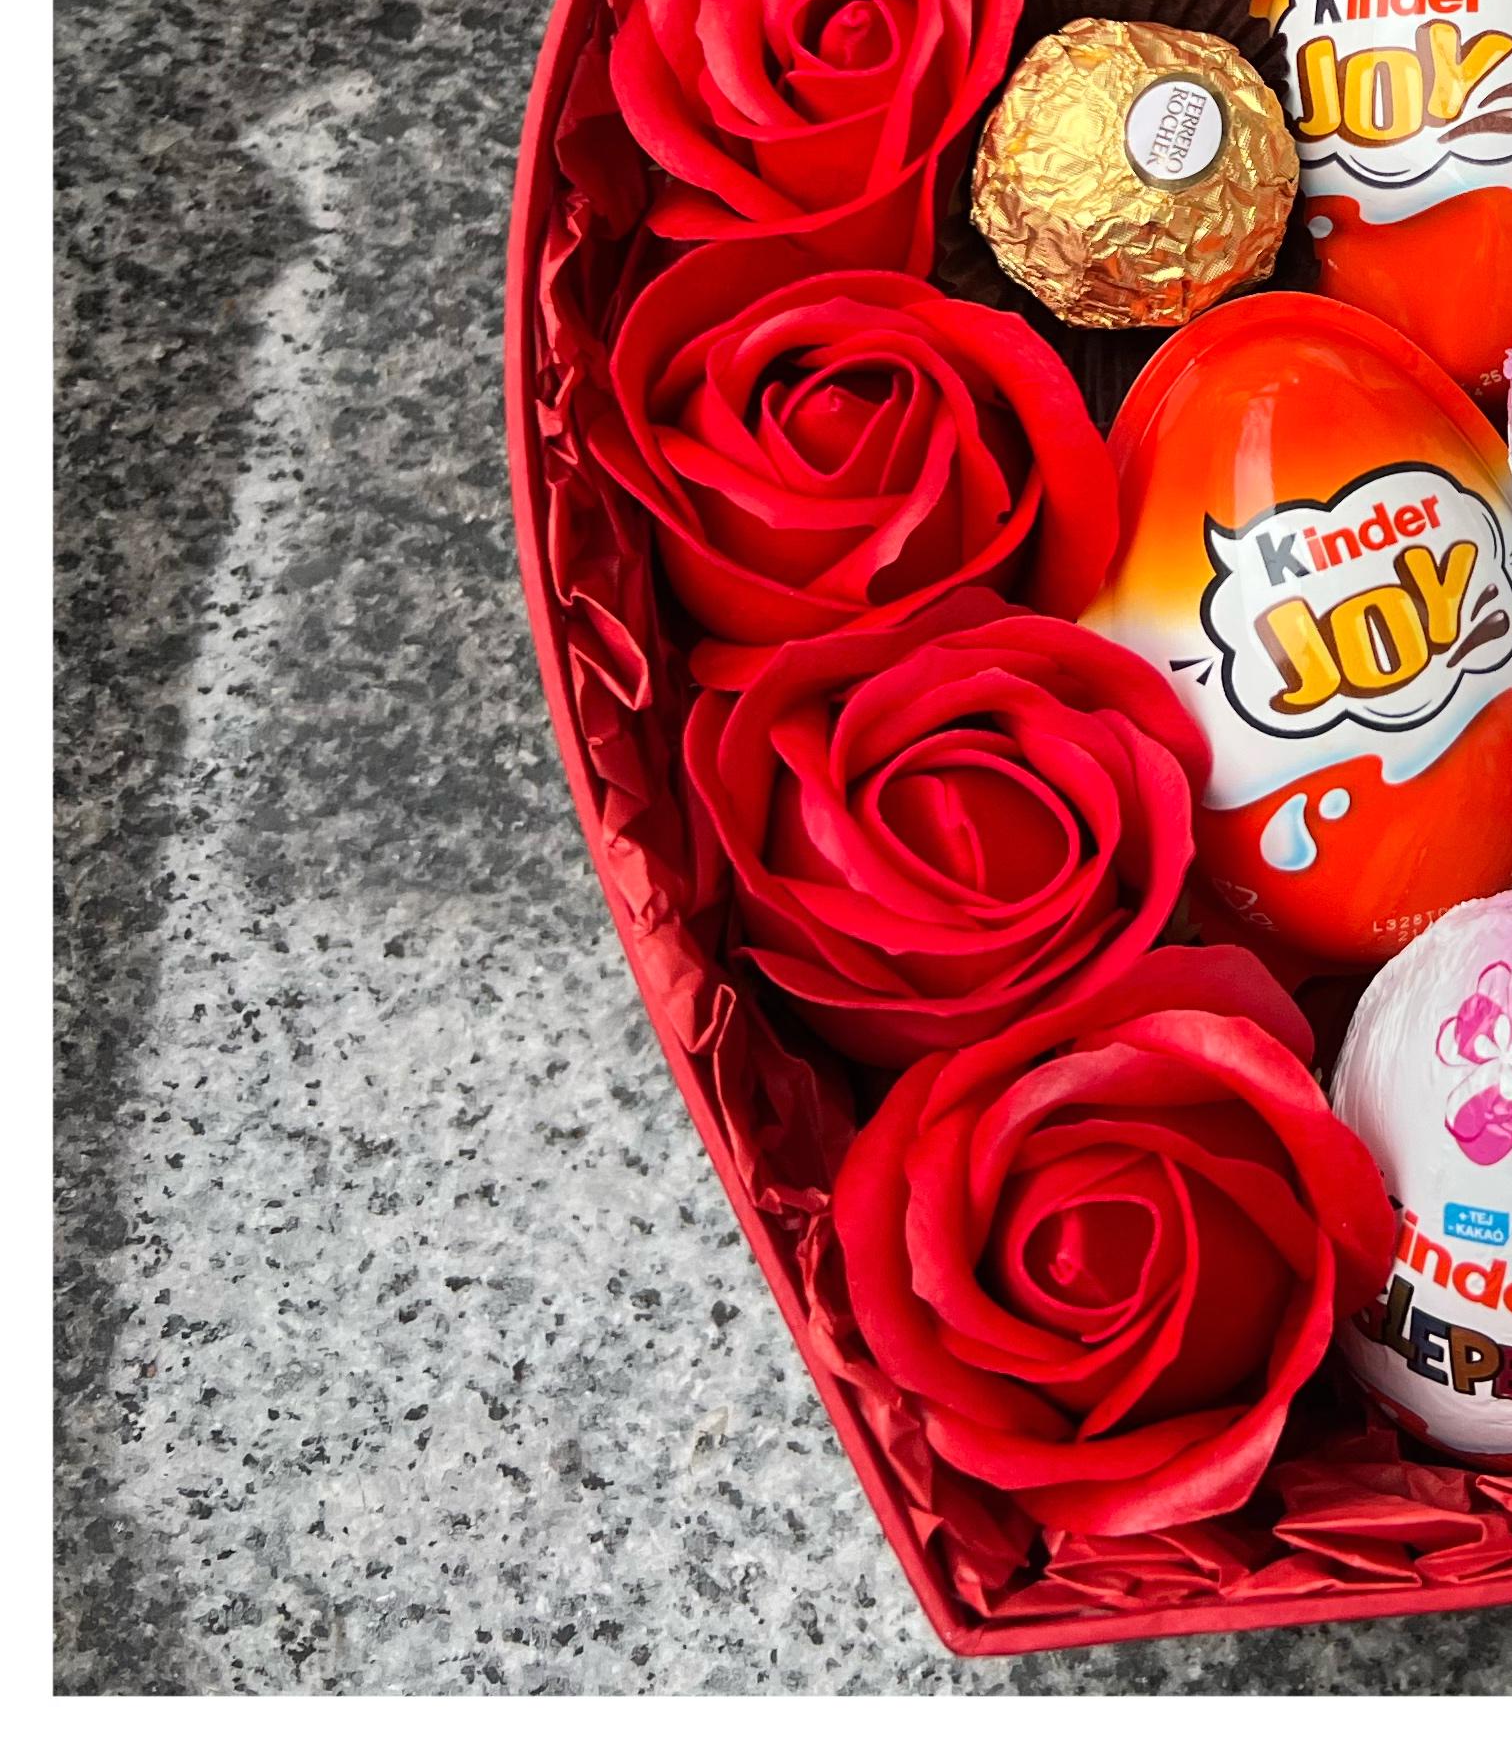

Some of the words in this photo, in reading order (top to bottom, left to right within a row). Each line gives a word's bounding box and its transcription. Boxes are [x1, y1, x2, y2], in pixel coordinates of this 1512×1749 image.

[1145, 86, 1190, 167] ROCHER
[1166, 92, 1208, 174] FERRERO
[1253, 539, 1479, 716] JOY
